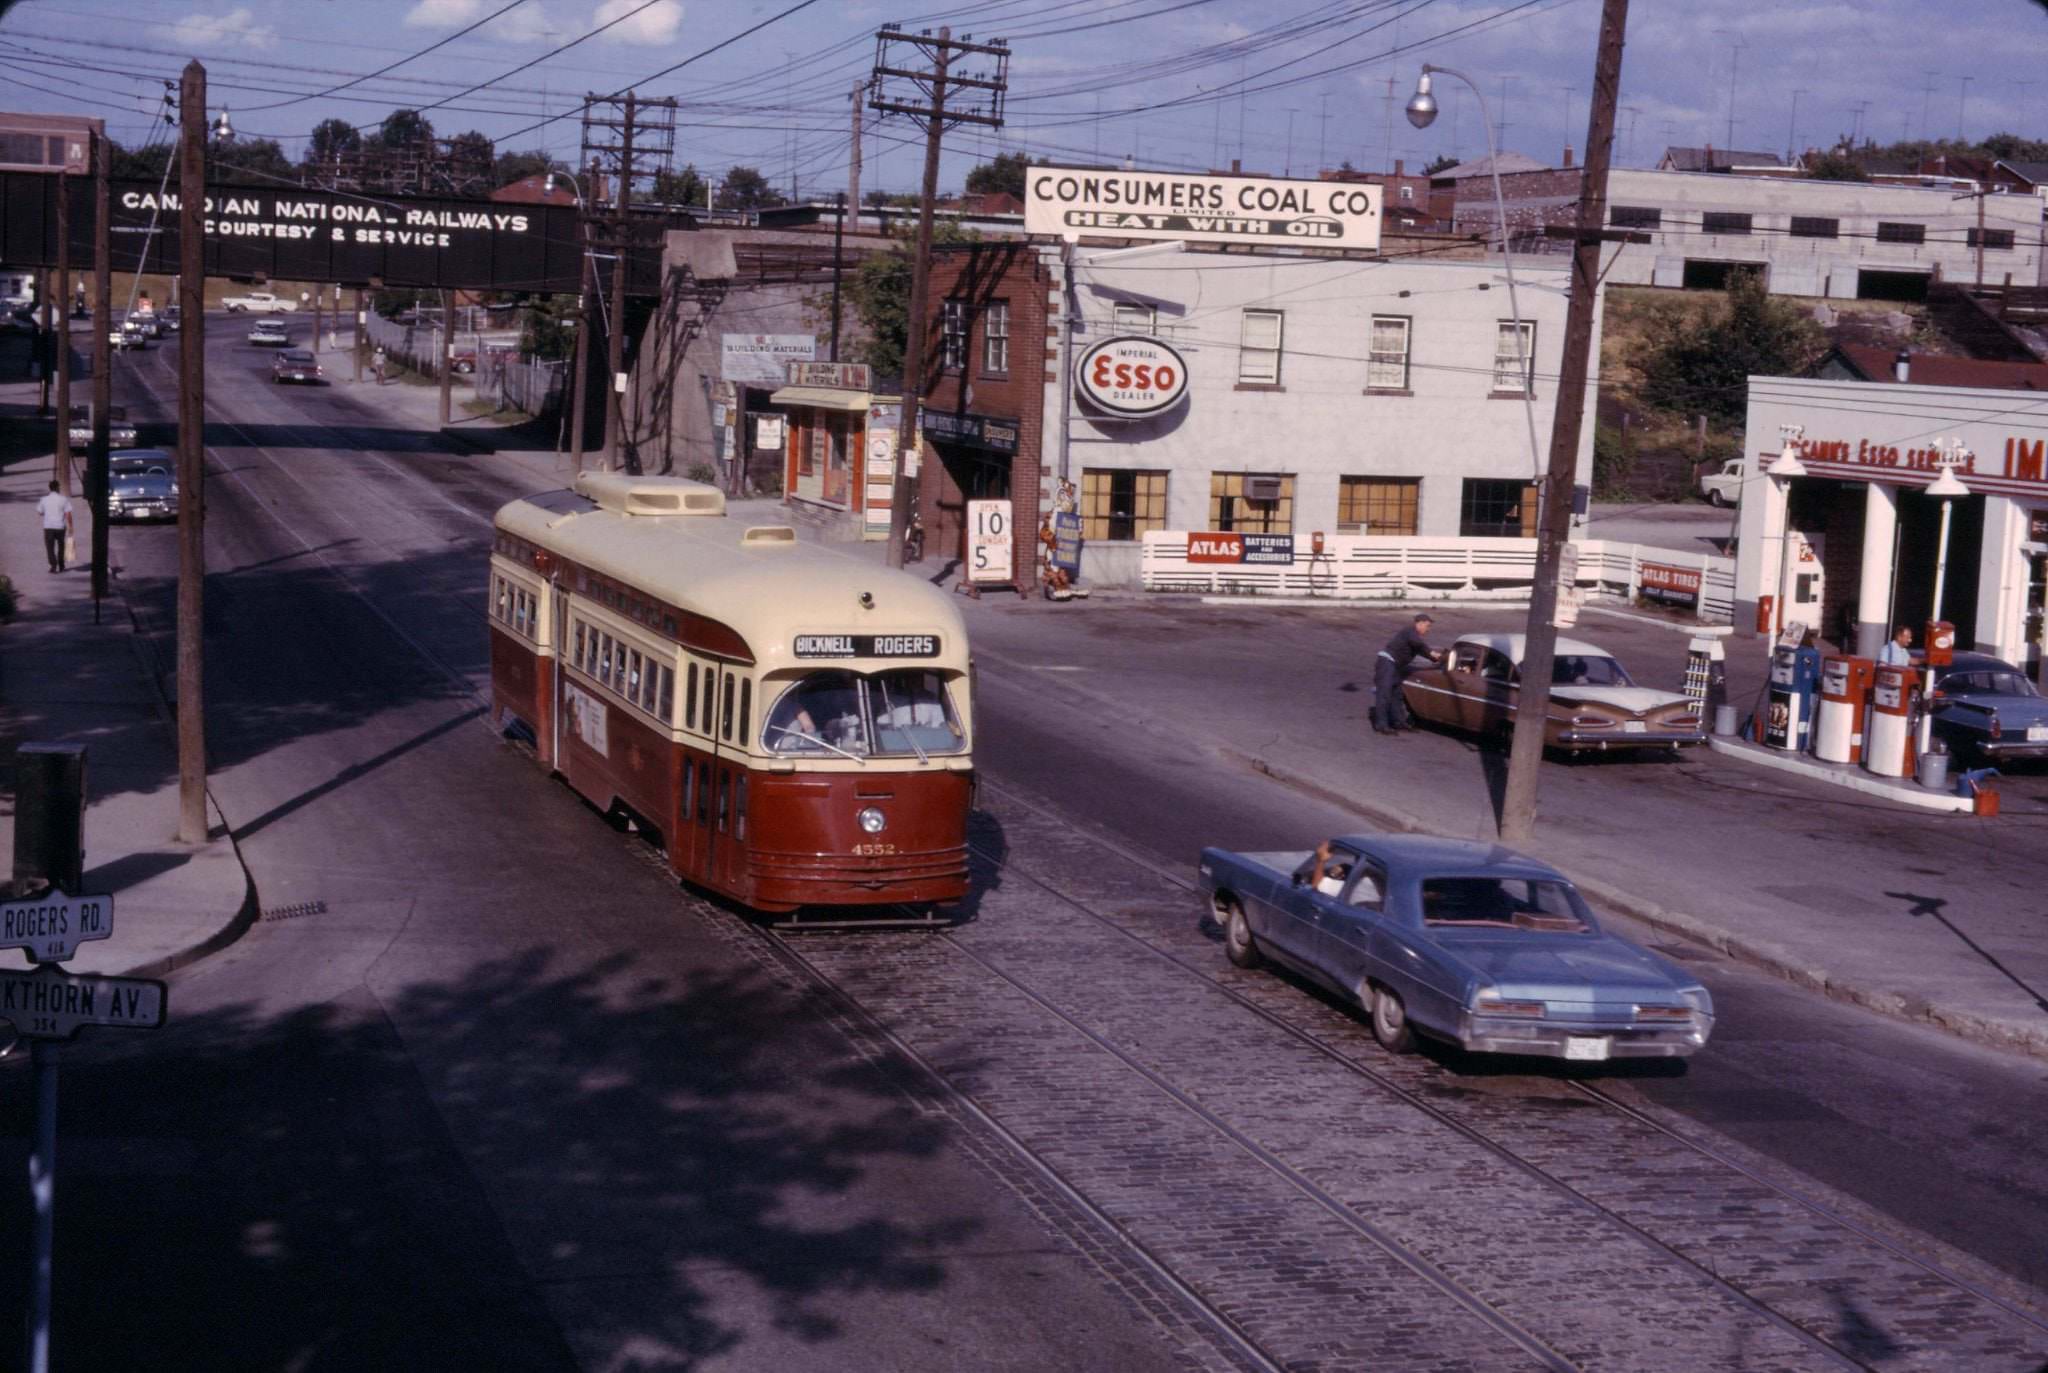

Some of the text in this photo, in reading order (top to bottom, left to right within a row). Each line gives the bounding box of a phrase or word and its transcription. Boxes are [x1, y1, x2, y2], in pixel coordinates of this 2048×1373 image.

[1034, 176, 1375, 216] CONSUMERS COAL CO.
[122, 192, 260, 215] CANDIAN
[406, 209, 529, 232] RAILWAYS
[1173, 208, 1235, 216] LIMITED
[204, 220, 450, 247] COURTESY & SERVICE
[1070, 212, 1337, 237] HEAT WITH OIL
[1117, 349, 1157, 359] IMPERIAL
[1113, 391, 1155, 400] DEALER
[978, 512, 1003, 535] 10
[1190, 541, 1240, 555] ATLAS
[1245, 537, 1291, 547] BATTERIES
[975, 546, 988, 569] 5
[1643, 567, 1699, 588] ATLAS TIRES
[796, 636, 933, 654] BICKNELL ROGERS
[851, 843, 896, 856] 4552
[4, 903, 106, 939] ROGERS RD.
[110, 987, 148, 1020] AV.
